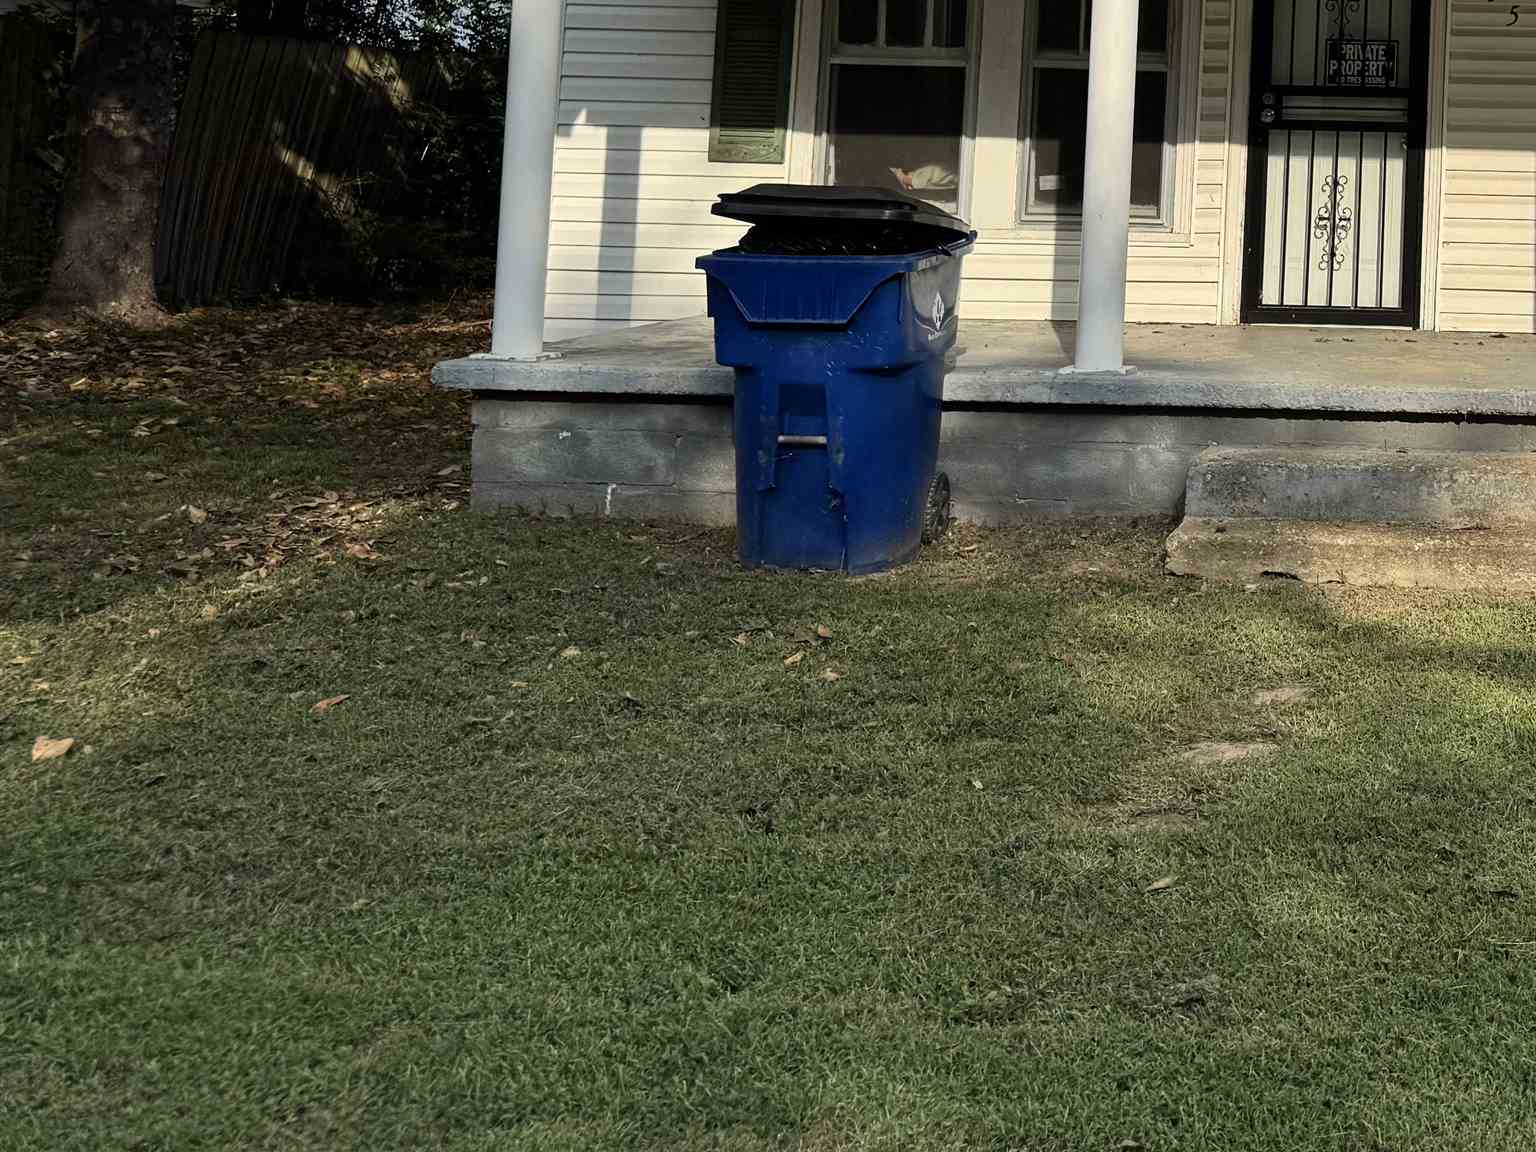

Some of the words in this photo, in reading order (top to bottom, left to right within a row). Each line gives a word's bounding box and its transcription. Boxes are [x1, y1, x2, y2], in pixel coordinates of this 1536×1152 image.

[1339, 44, 1386, 60] PRIVATE
[1329, 60, 1393, 76] PROPERTY
[1346, 76, 1386, 84] TRESASSING
